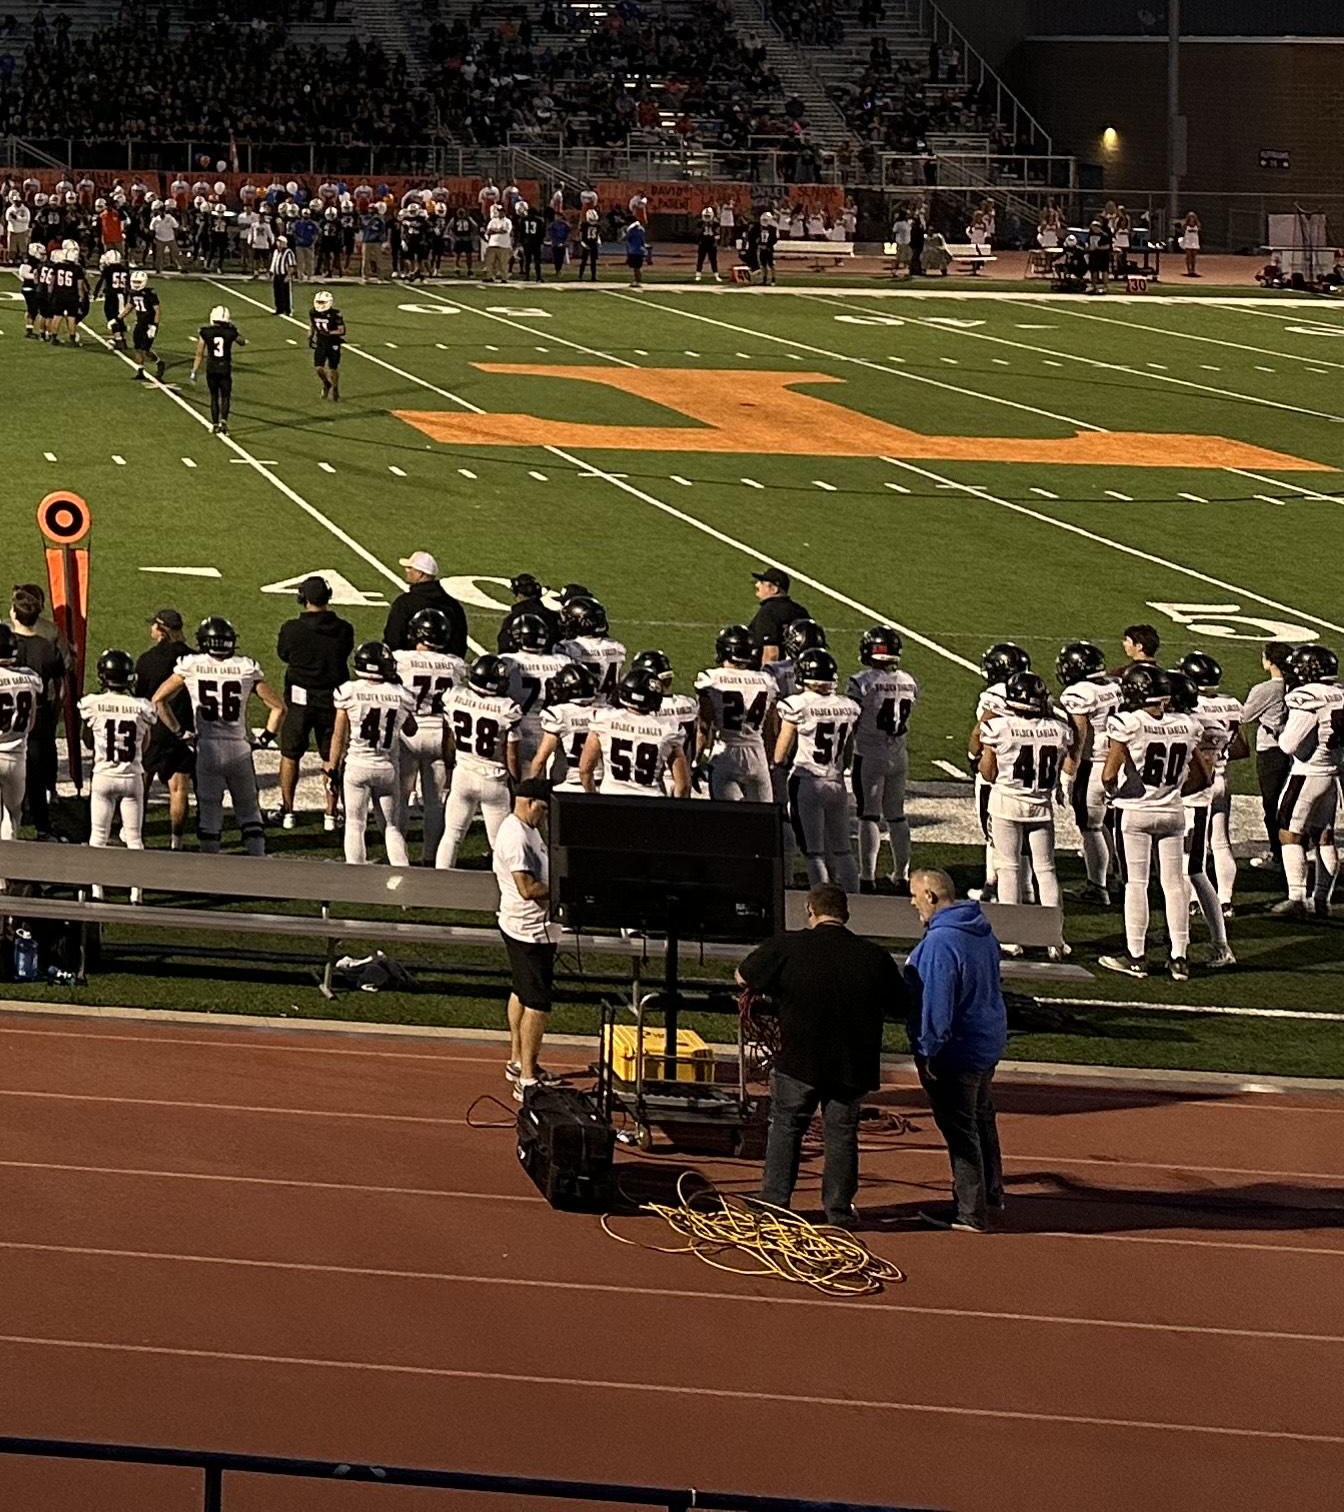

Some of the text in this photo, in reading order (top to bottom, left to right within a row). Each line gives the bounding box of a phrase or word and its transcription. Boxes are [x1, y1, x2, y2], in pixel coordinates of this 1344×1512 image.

[525, 221, 537, 234] 13
[57, 270, 73, 287] 66
[112, 272, 127, 288] 55
[1131, 279, 1146, 291] 30
[213, 337, 224, 357] 3
[198, 679, 242, 722] 56
[722, 691, 768, 731] 24
[104, 719, 137, 763] 13
[360, 707, 398, 749] 41
[453, 709, 499, 758] 28
[813, 722, 849, 765] 51
[610, 737, 659, 786] 59
[1013, 745, 1058, 788] 40
[1143, 742, 1188, 786] 60
